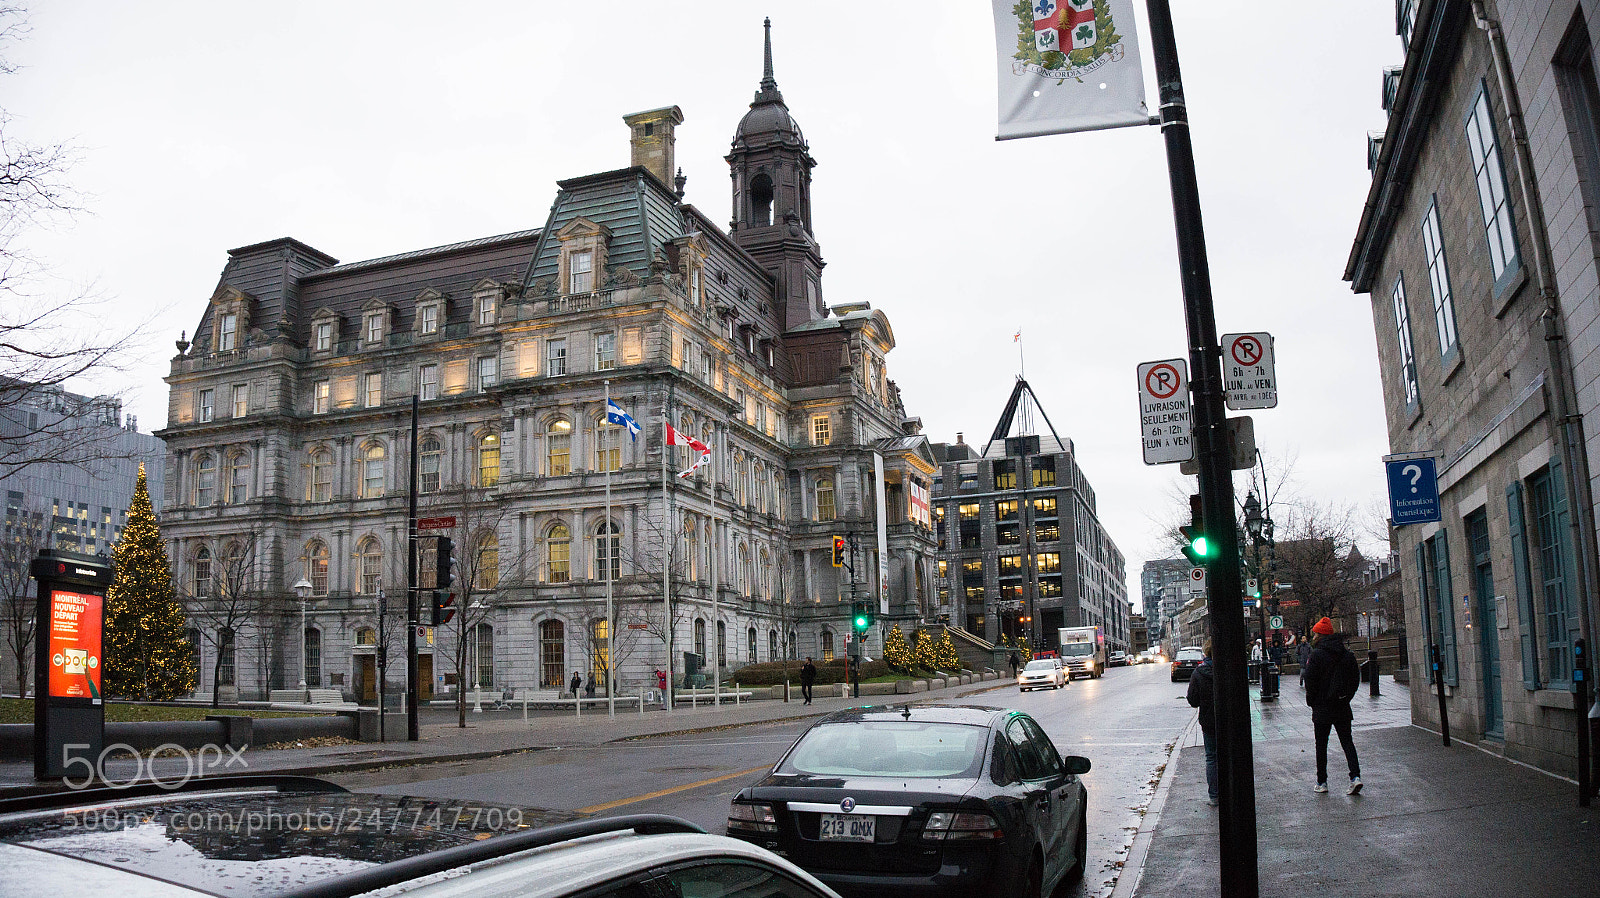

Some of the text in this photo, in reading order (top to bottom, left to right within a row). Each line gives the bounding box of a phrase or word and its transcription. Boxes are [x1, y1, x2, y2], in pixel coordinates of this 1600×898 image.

[1031, 57, 1106, 78] CONCORDIA SALUS
[1243, 342, 1254, 358] P
[1233, 366, 1244, 377] 6h
[1255, 365, 1265, 376] 7h
[1157, 371, 1171, 391] P
[1226, 380, 1246, 391] LUN.
[1254, 378, 1274, 389] VEN.
[1144, 400, 1186, 414] LIVRAISON
[1143, 411, 1189, 425] SEULEMENT
[1151, 427, 1162, 436] 6h
[1169, 425, 1182, 435] 12h
[1146, 438, 1162, 449] LUN
[1172, 436, 1190, 446] VEN
[1396, 498, 1434, 507] Information
[54, 593, 90, 606] MONTRÉAL,
[54, 602, 85, 613] NOUVEAU
[54, 610, 79, 621] DÉPART
[822, 819, 845, 835] 213
